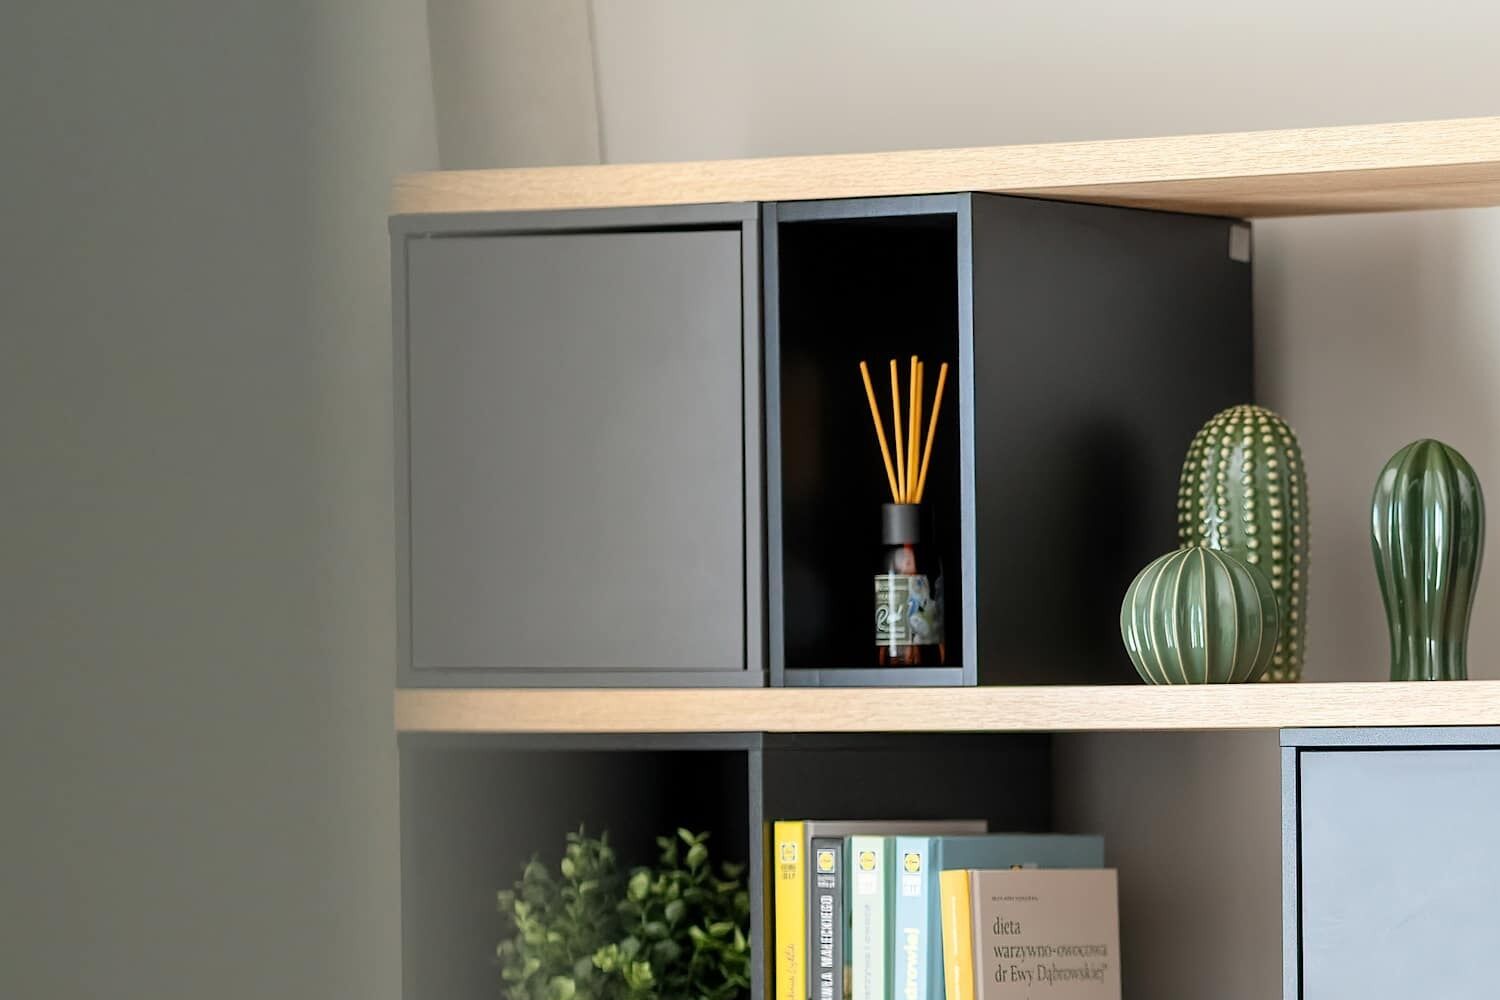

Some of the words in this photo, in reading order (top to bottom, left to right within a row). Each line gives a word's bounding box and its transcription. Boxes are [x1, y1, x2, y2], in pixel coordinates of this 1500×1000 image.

[820, 895, 834, 968] MAŁECKIEGO
[993, 915, 1022, 936] dieta
[994, 963, 1008, 983] dr
[1010, 964, 1033, 988] Ewy
